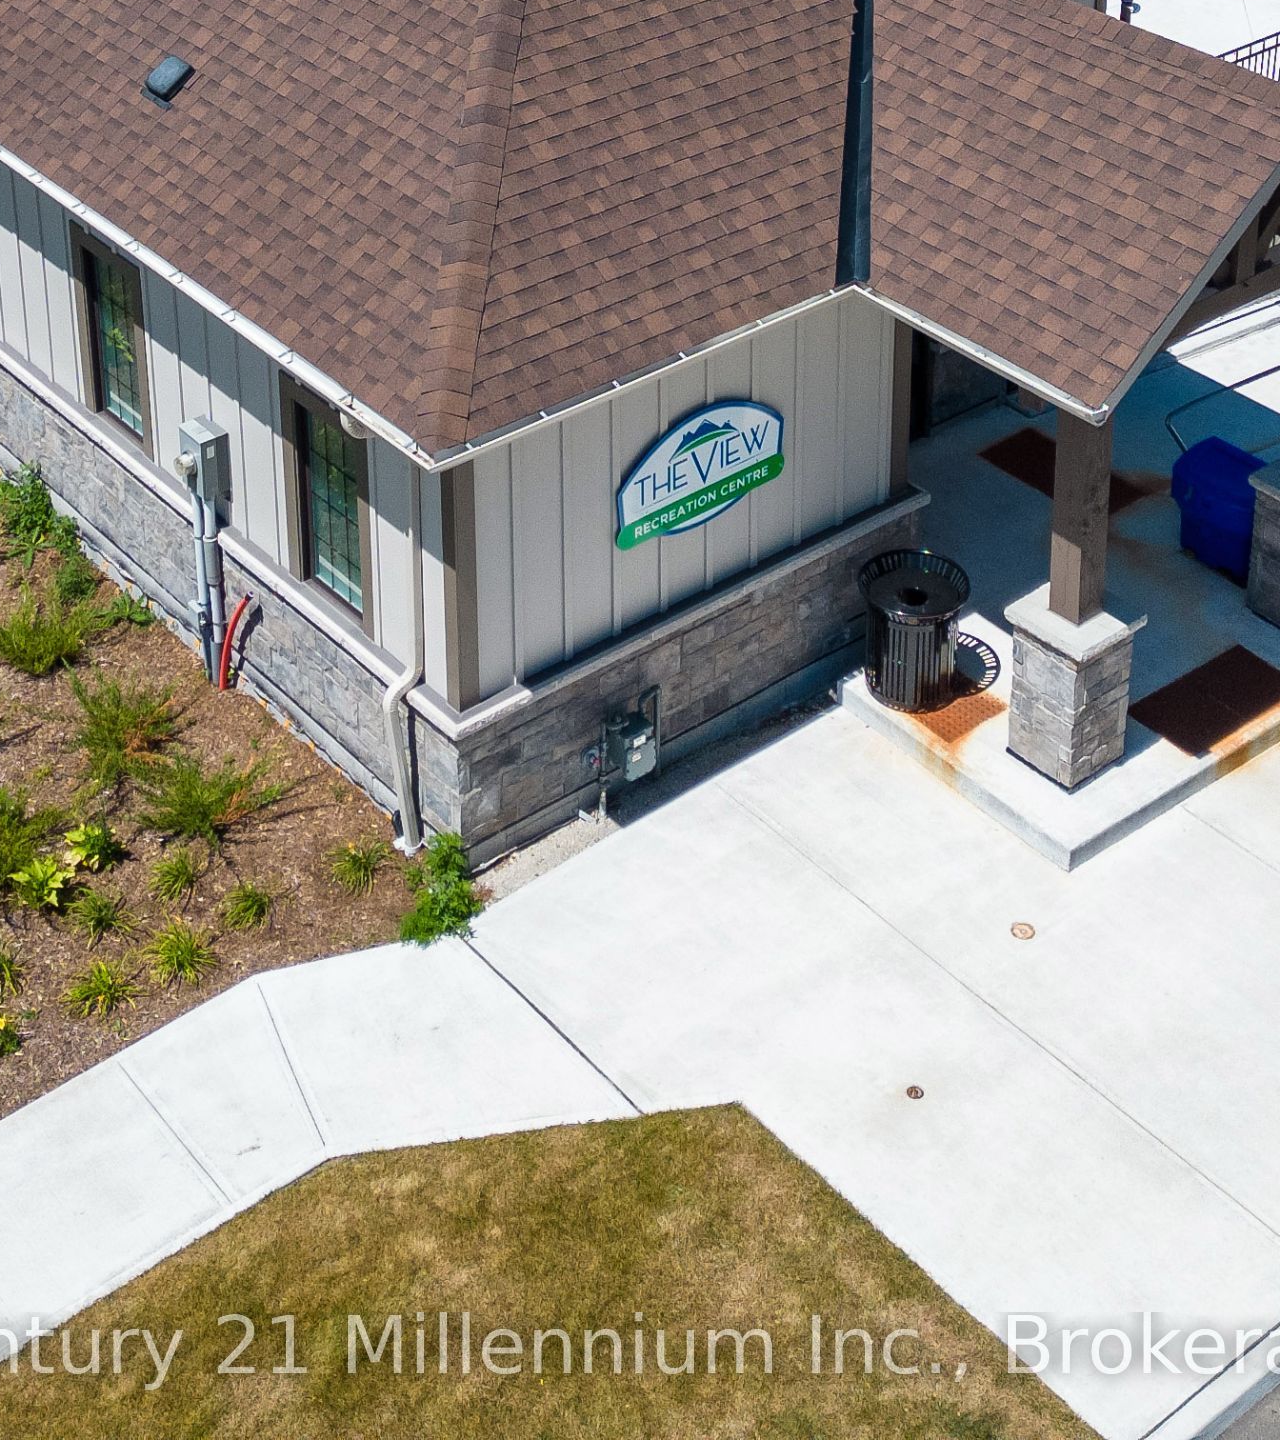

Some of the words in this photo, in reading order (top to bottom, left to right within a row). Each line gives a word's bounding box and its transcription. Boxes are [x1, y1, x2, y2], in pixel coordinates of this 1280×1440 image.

[634, 457, 688, 506] THE
[690, 420, 770, 484] VIEW
[634, 490, 717, 539] RECREATION
[720, 465, 769, 497] CENTRE
